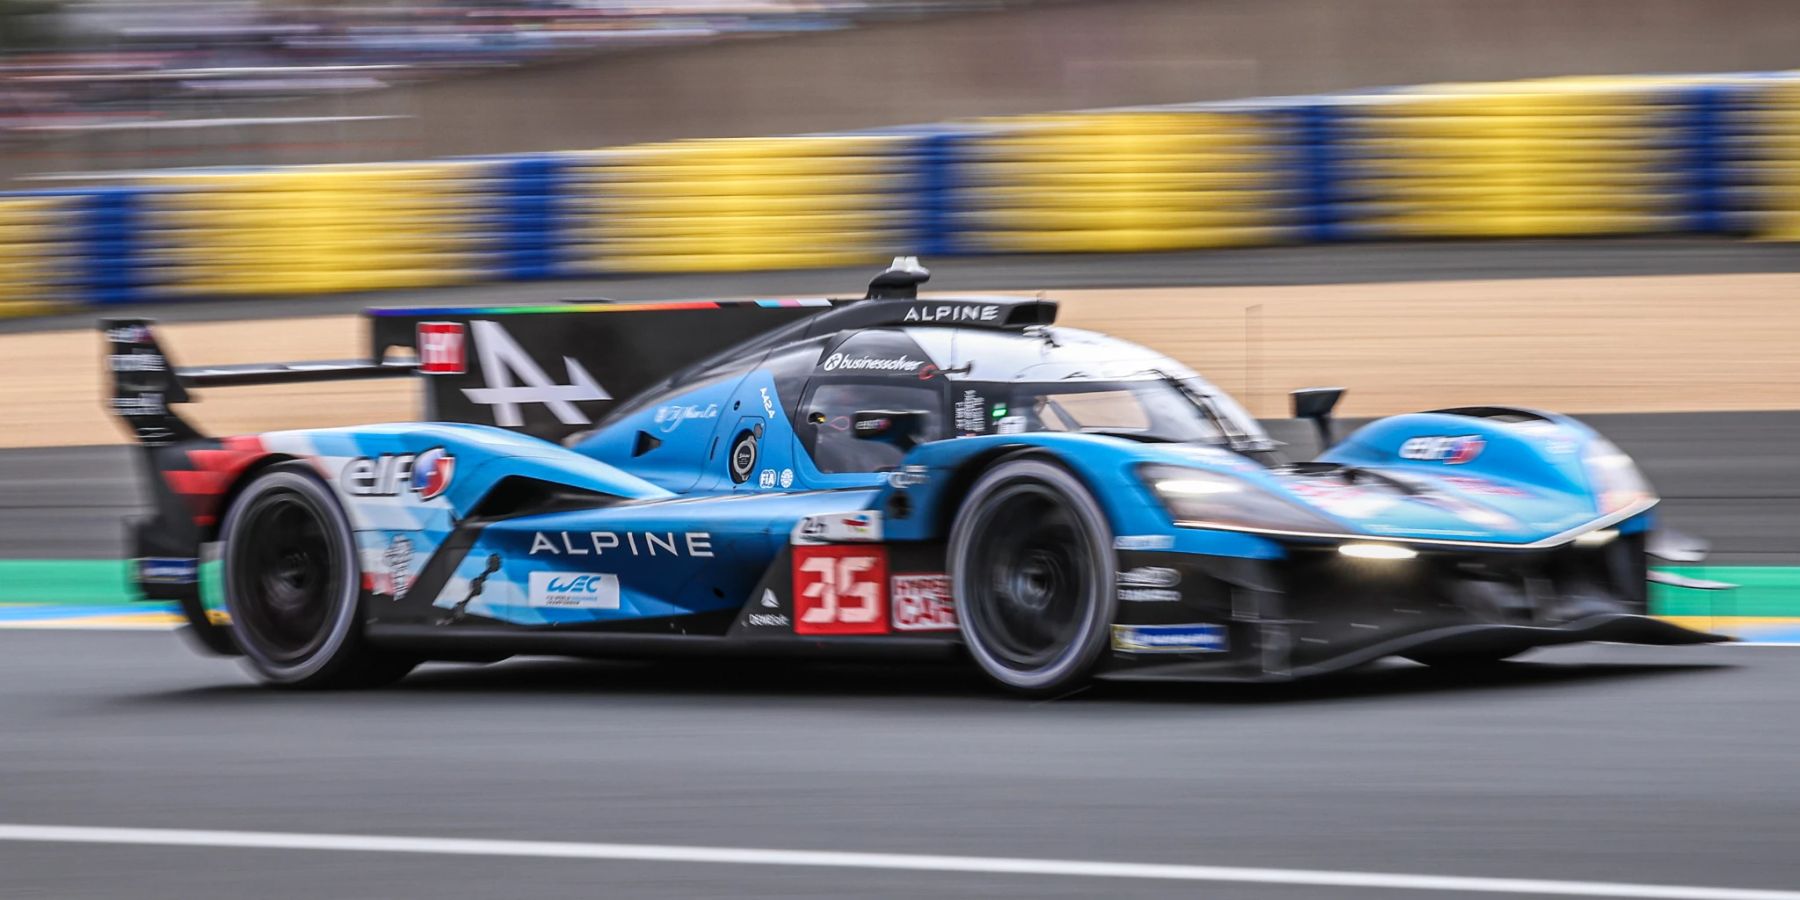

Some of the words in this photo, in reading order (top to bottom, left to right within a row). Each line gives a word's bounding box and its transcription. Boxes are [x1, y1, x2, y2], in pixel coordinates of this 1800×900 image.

[904, 305, 999, 322] ALPINE
[840, 354, 924, 371] businessolver
[340, 453, 416, 495] elf
[528, 531, 715, 557] ALPINE
[546, 575, 601, 593] WEC
[799, 556, 881, 624] 35
